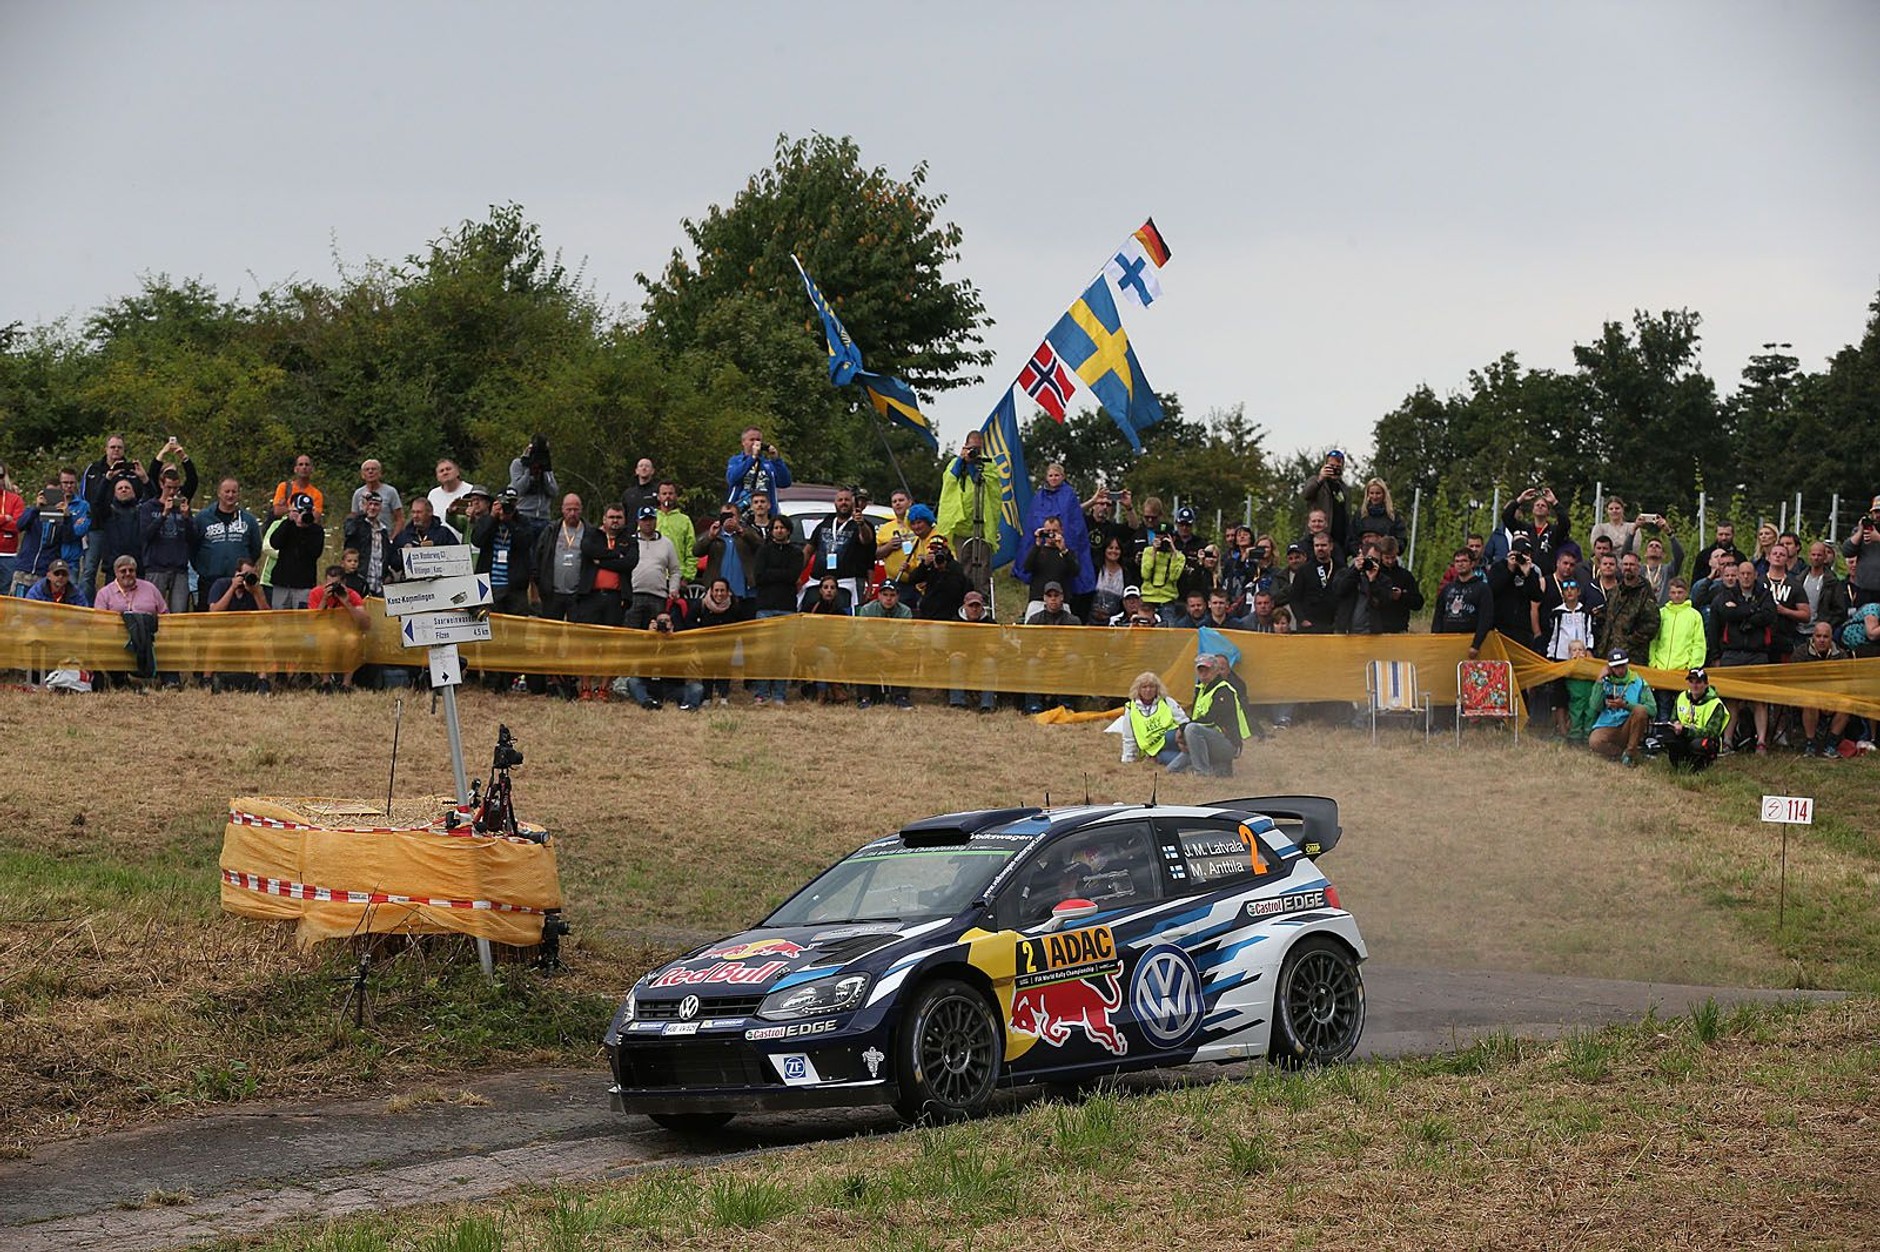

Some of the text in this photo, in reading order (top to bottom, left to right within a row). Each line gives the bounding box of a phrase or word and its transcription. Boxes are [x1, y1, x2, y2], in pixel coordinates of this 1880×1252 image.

[1788, 799, 1807, 821] 114
[970, 833, 1033, 841] Volkswagen
[1209, 839, 1245, 854] Latvala
[1238, 824, 1268, 875] 2
[1190, 861, 1245, 877] M. Anttila
[1254, 890, 1325, 915] Castrol EDGE
[1022, 941, 1037, 973] 2
[1051, 928, 1112, 968] ADAC
[648, 961, 788, 987] Red Bull
[1065, 966, 1095, 977] Championship
[752, 1020, 838, 1039] Castrol EDGE
[788, 1061, 802, 1073] ZF
